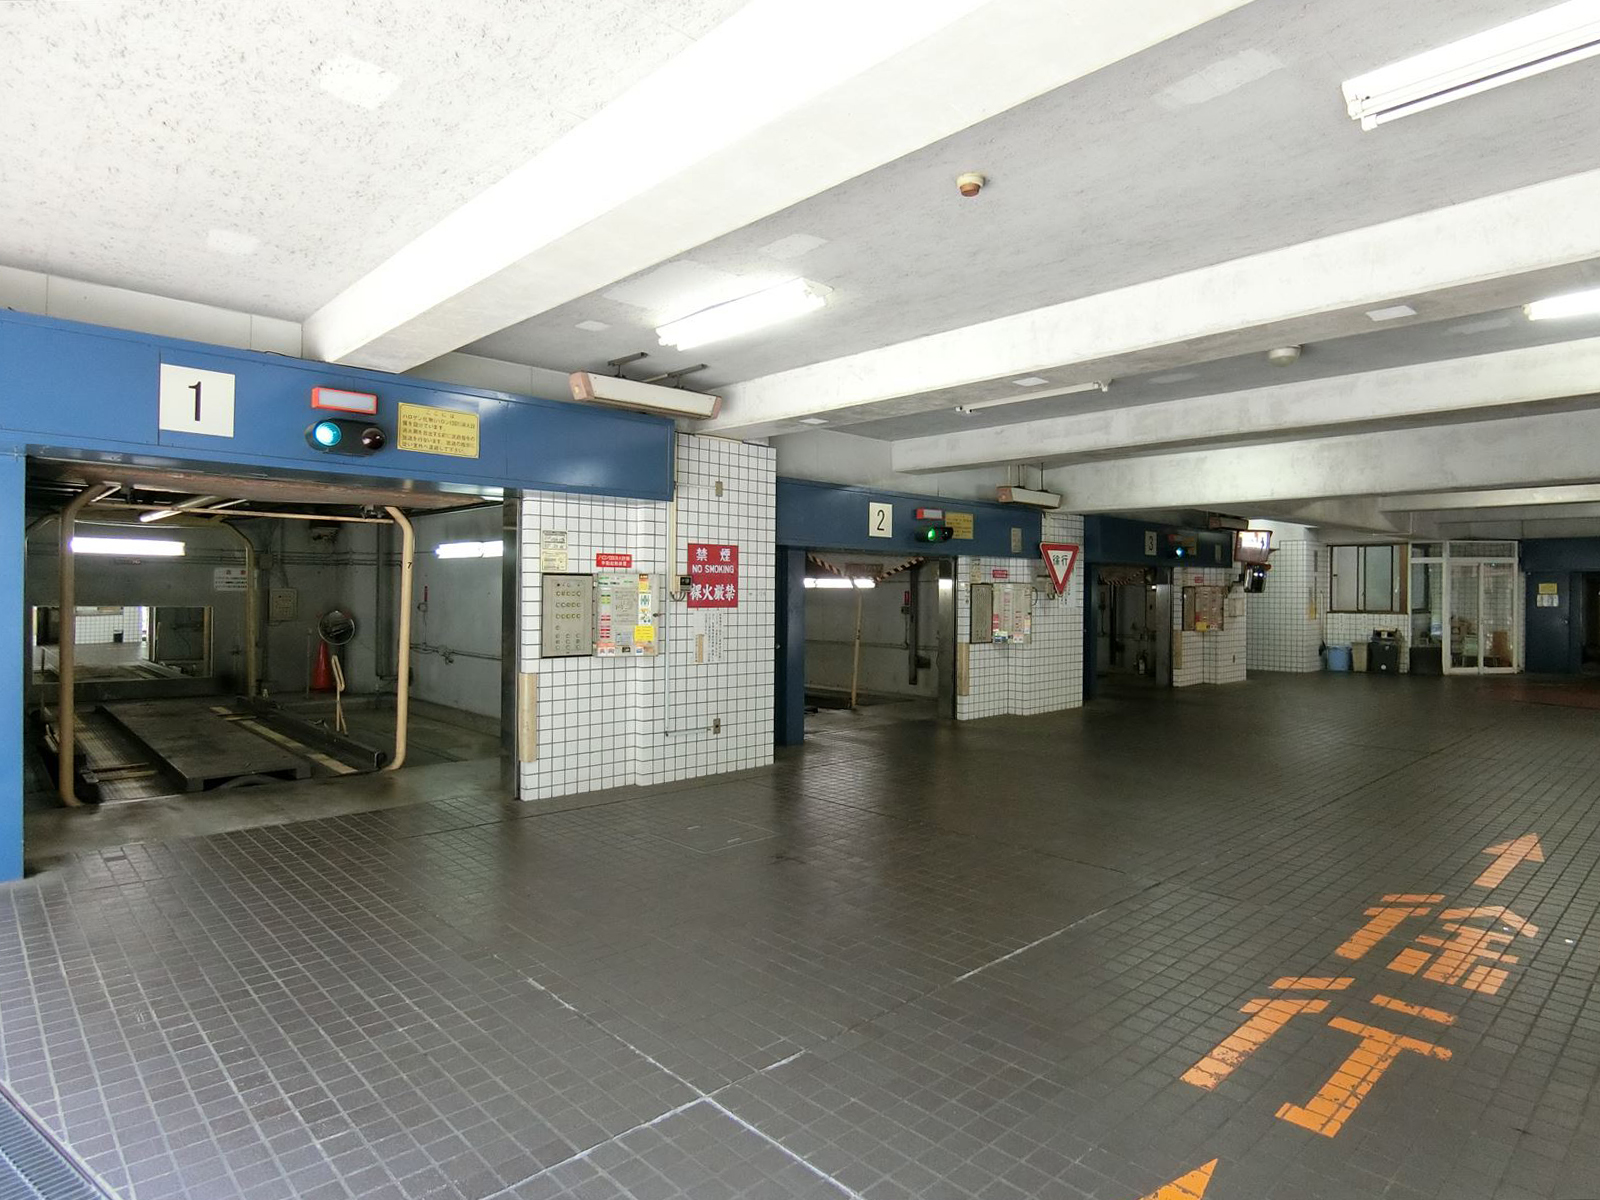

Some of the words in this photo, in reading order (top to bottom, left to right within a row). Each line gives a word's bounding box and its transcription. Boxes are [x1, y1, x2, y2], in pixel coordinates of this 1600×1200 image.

[188, 381, 202, 421] 1
[877, 509, 885, 531] 2
[1148, 535, 1153, 551] 3
[692, 564, 702, 573] NO
[705, 564, 734, 573] SMOKING
[1052, 554, 1069, 566] 徐行
[690, 583, 735, 601] 裸火厳禁
